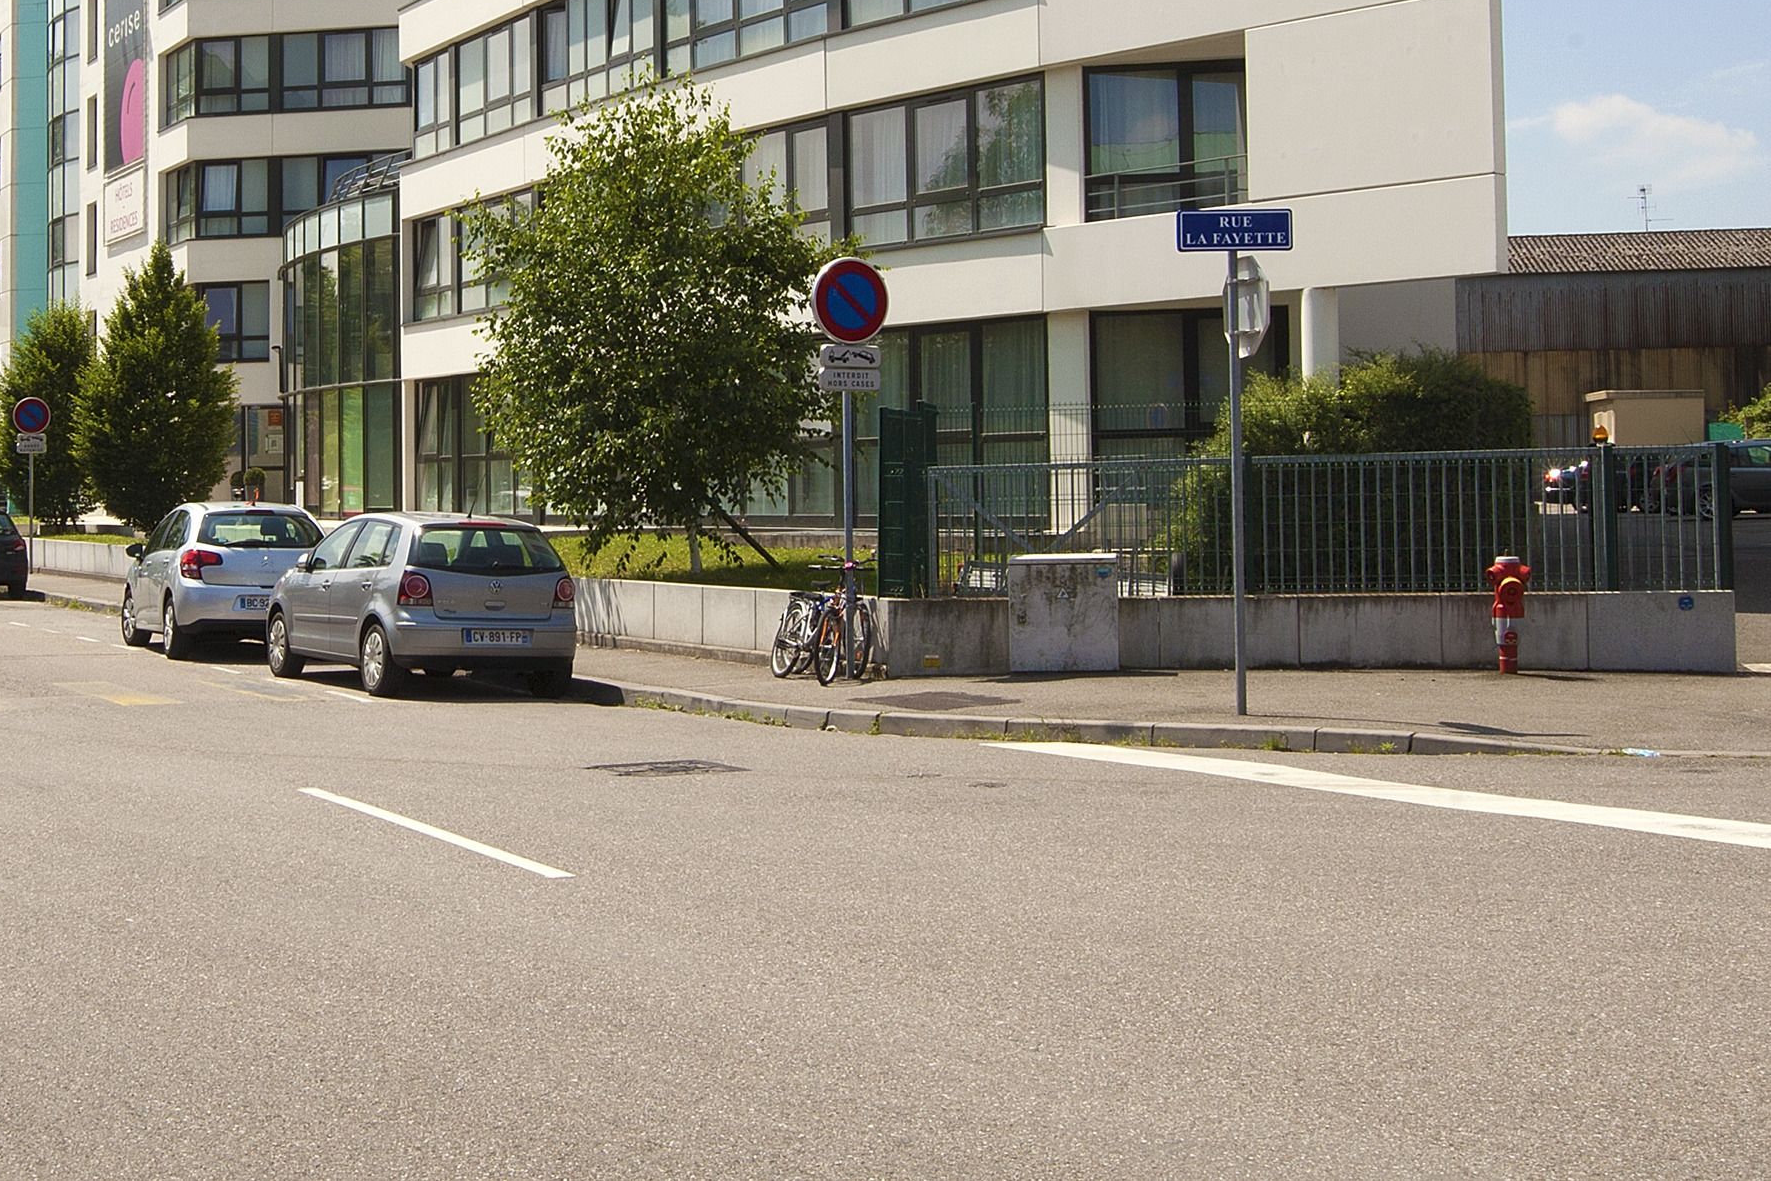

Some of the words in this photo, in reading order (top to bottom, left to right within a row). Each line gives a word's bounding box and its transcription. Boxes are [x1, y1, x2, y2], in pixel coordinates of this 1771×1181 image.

[107, 9, 140, 48] cerise
[1219, 215, 1253, 228] RUE
[1185, 232, 1207, 245] LA
[1212, 231, 1287, 245] FAYETTE
[832, 371, 870, 380] INTERDIT
[828, 379, 848, 387] HORS
[850, 380, 876, 388] CASES
